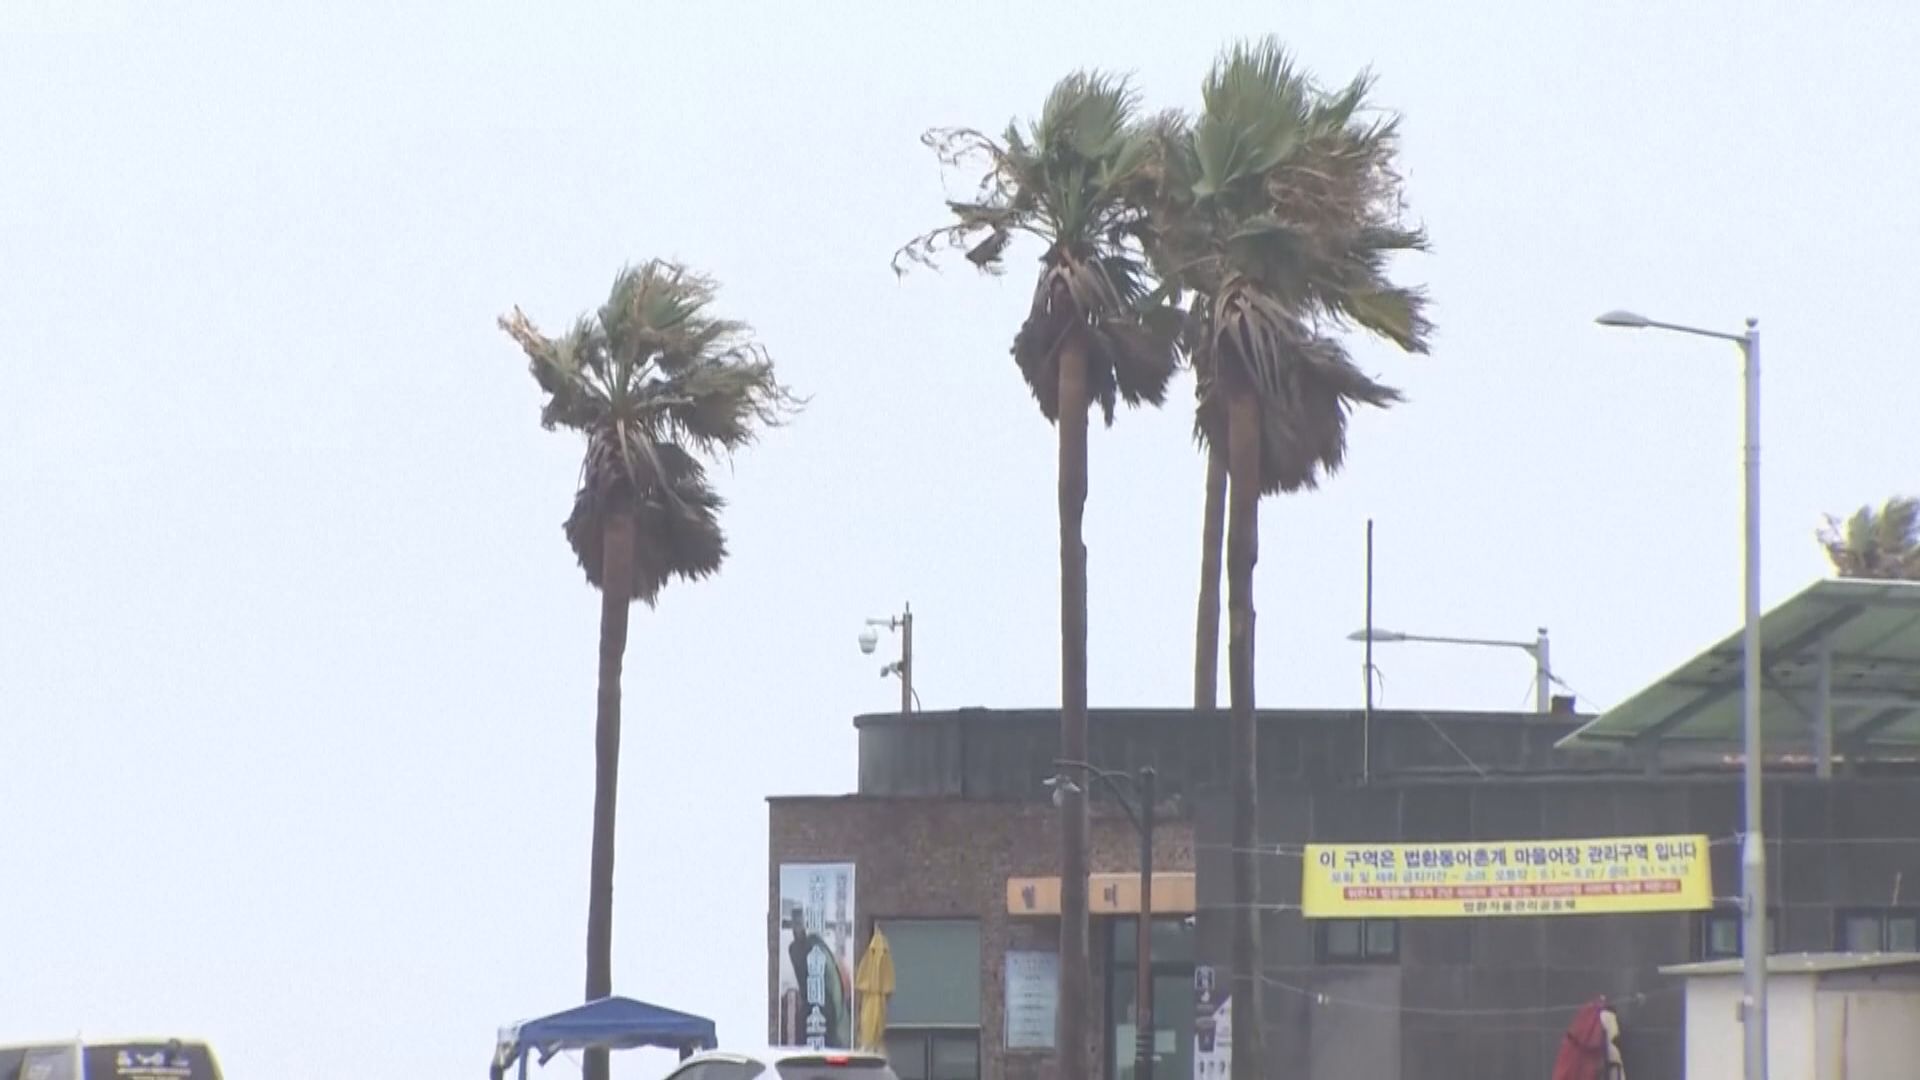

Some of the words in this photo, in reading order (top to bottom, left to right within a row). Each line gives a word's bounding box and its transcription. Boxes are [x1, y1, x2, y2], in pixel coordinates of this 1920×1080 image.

[1320, 850, 1336, 868] 이
[1344, 849, 1395, 868] 구역은
[1405, 847, 1507, 868] 법환동어촌계
[1515, 845, 1580, 866] 마을어장
[1588, 843, 1648, 864] 관리구역
[1655, 841, 1696, 861] 입니다
